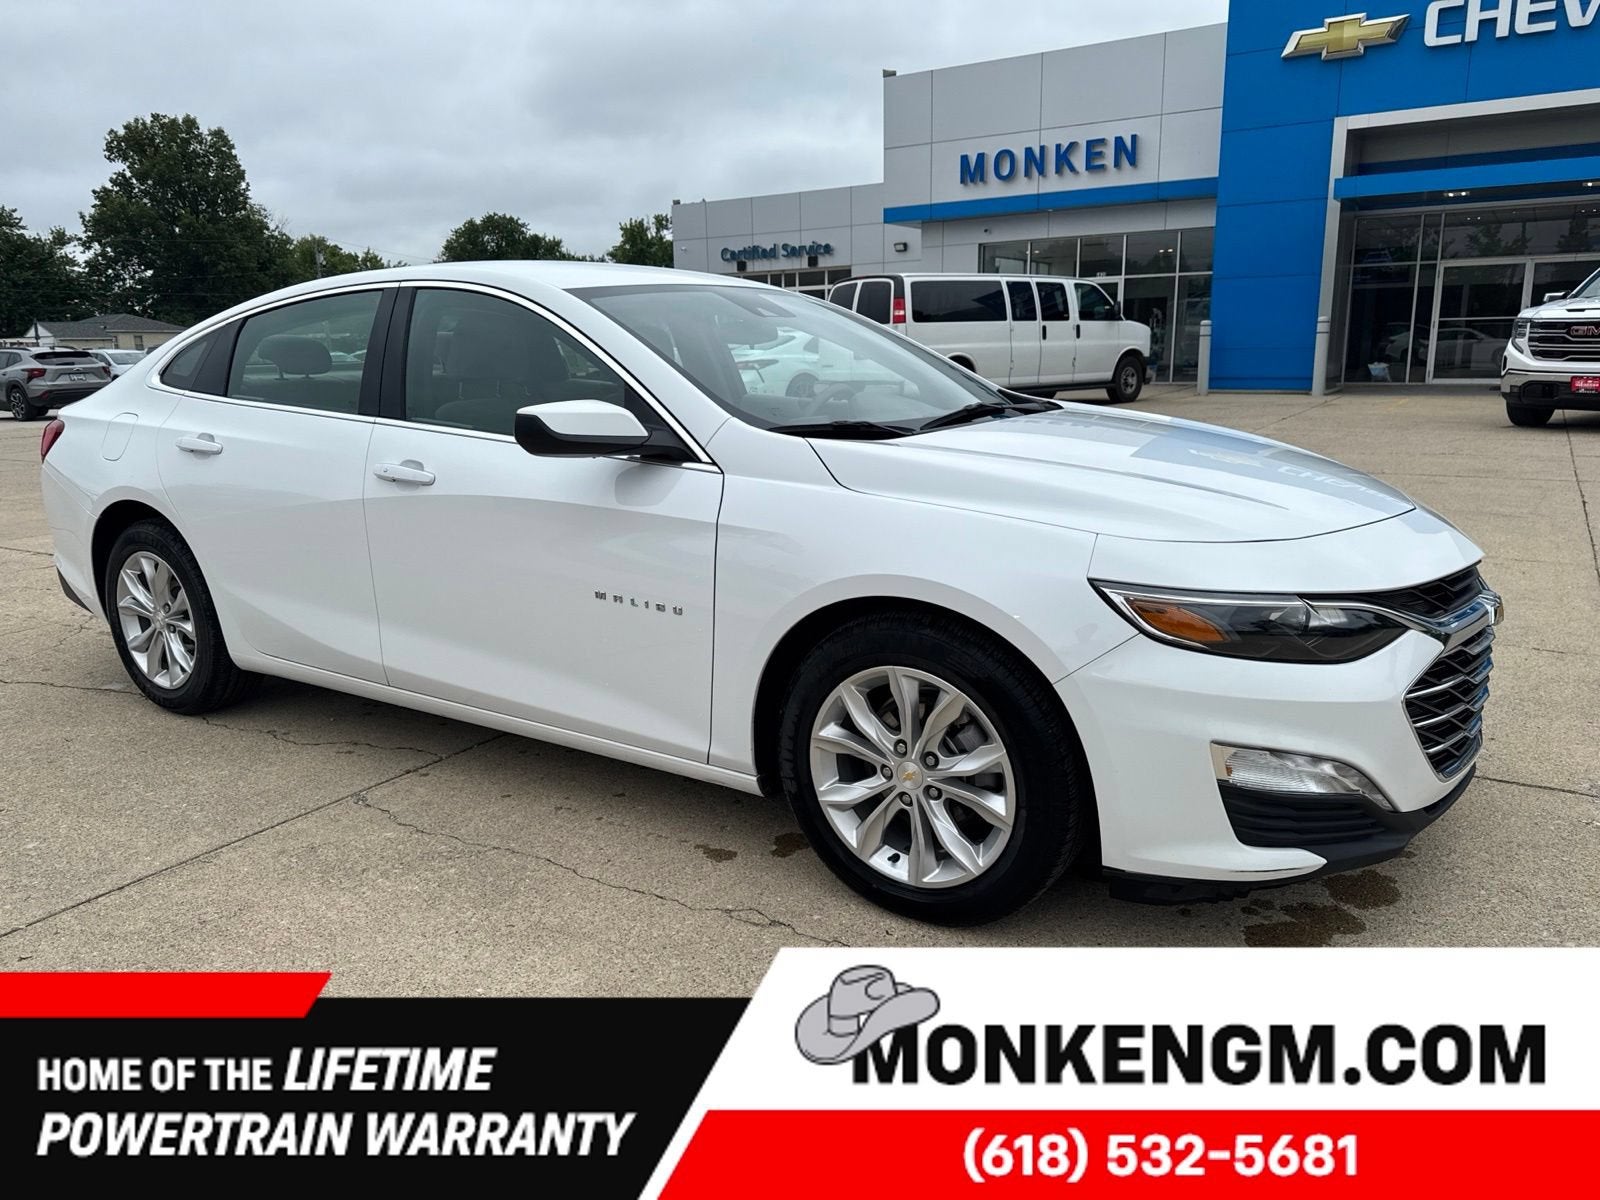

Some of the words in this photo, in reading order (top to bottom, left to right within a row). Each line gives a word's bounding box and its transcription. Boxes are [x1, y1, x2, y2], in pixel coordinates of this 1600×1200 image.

[1424, 0, 1600, 47] CHEV
[960, 134, 1138, 185] MONKEN
[721, 244, 779, 262] Certified
[781, 241, 834, 257] Service
[594, 590, 684, 616] MALIBU
